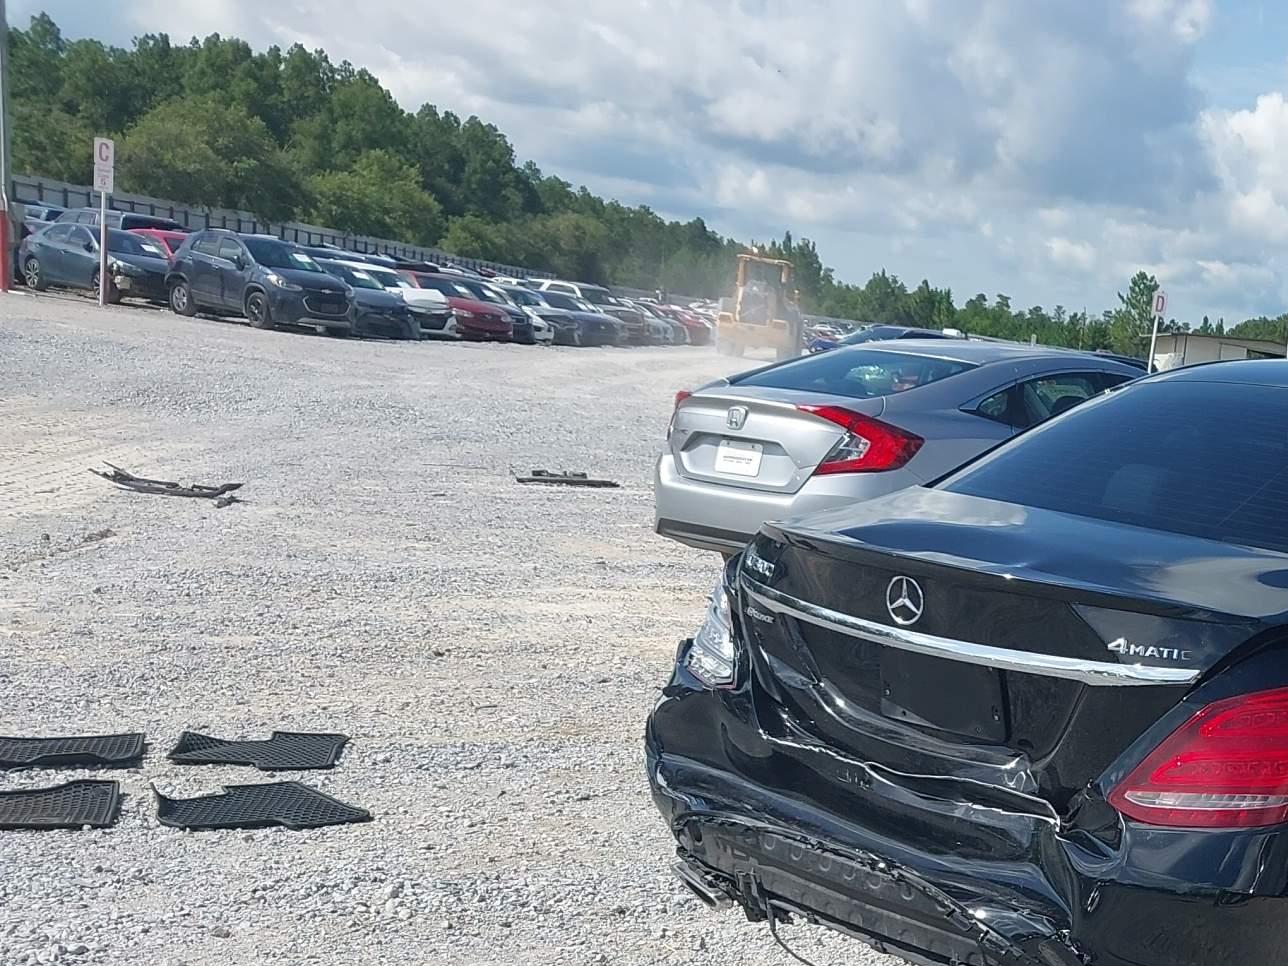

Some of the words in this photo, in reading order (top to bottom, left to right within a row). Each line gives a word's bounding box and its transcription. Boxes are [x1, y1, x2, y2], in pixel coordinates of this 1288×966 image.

[98, 142, 110, 162] C
[1155, 295, 1165, 313] D
[1107, 637, 1193, 661] 4MATIC
